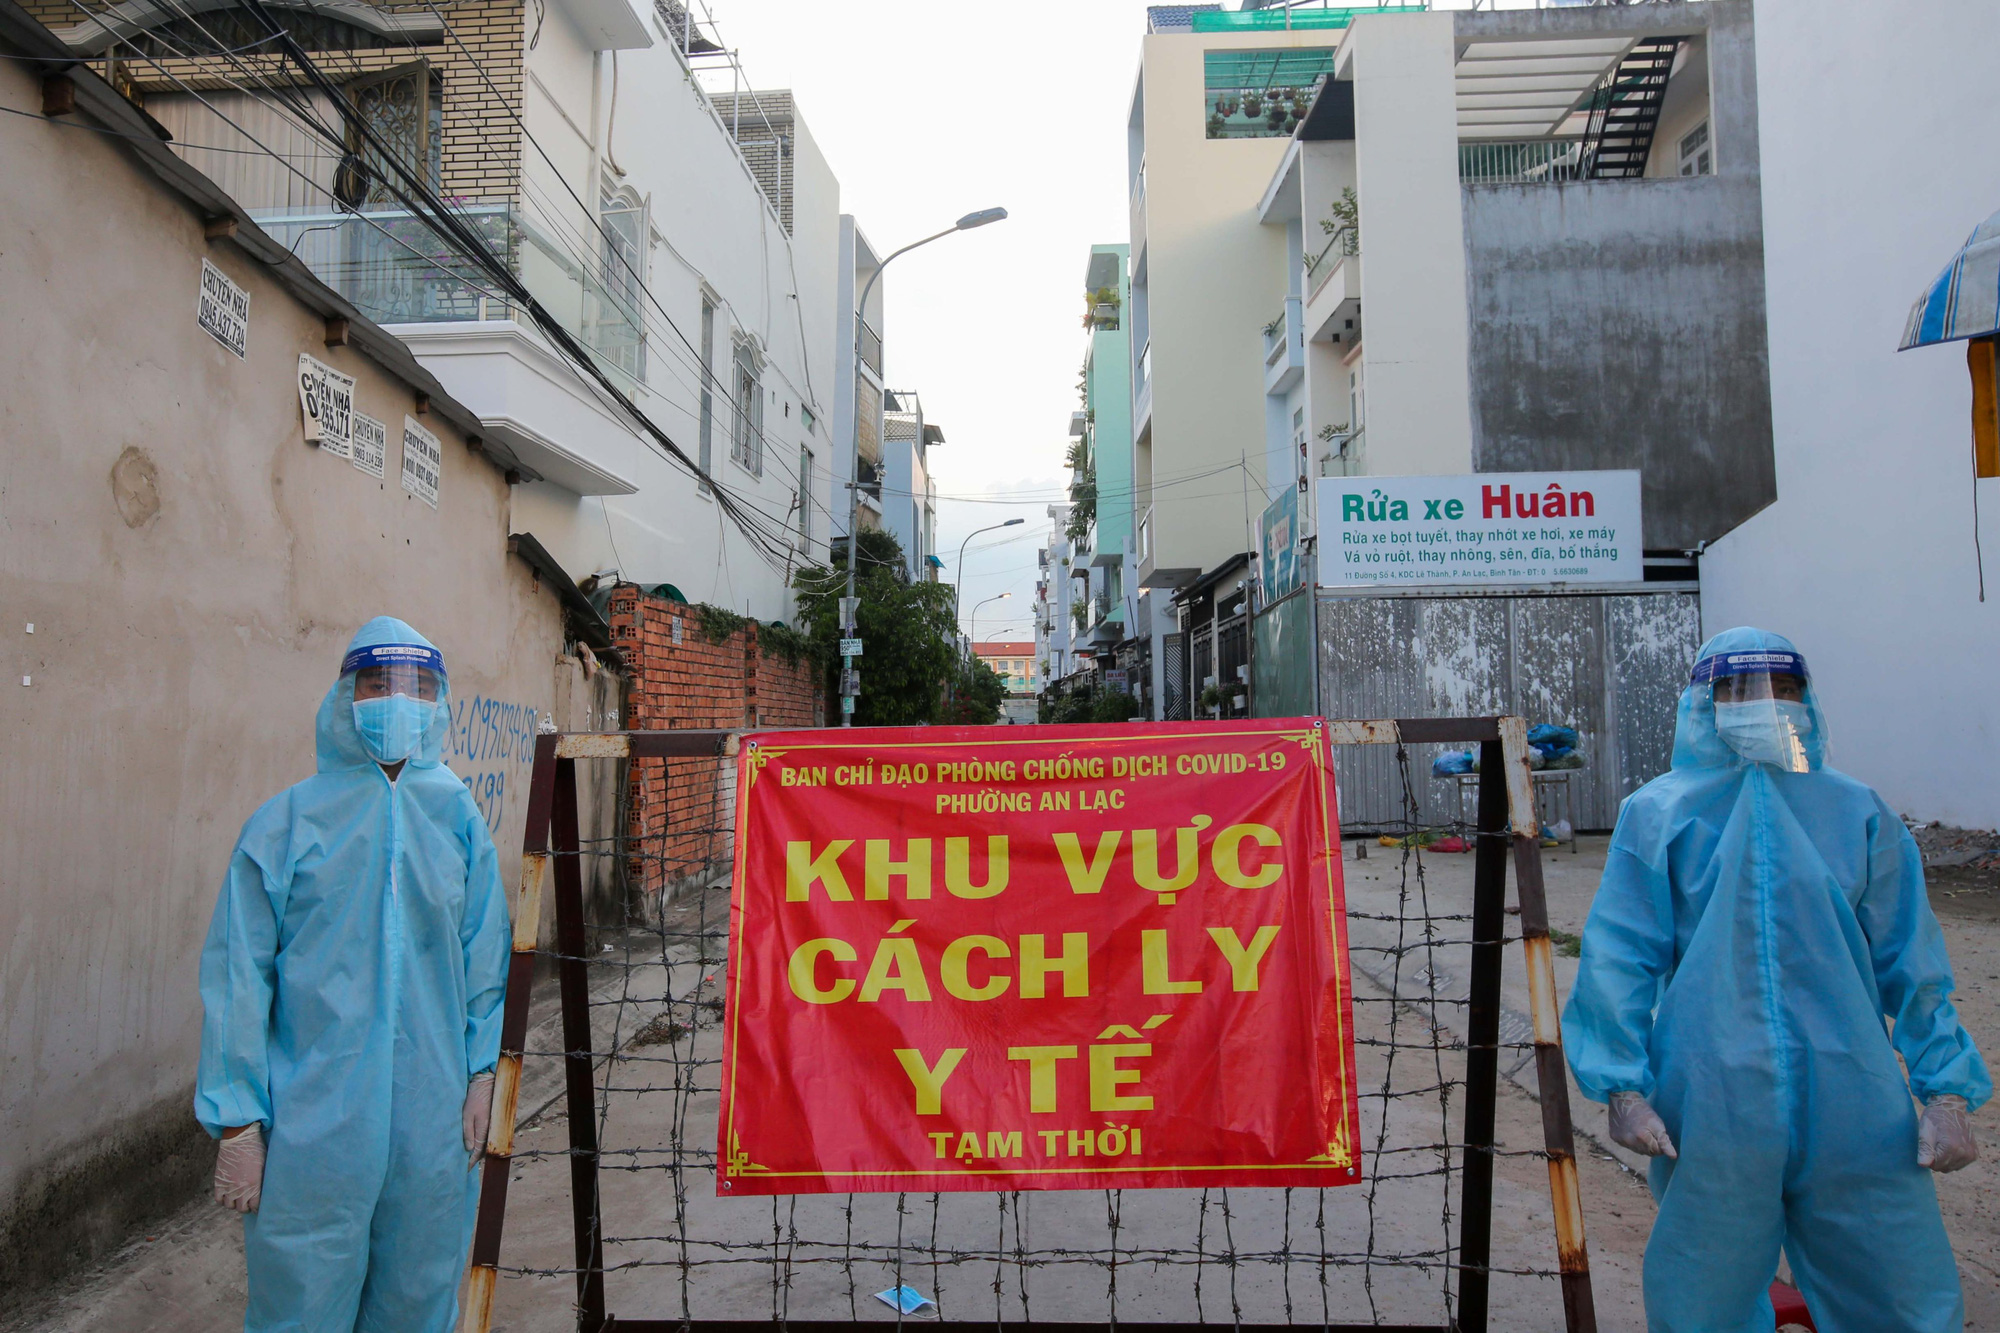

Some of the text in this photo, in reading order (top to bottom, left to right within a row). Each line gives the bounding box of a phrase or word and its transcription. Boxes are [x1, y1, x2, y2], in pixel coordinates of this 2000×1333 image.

[200, 295, 244, 349] 0945.437.734
[333, 389, 351, 413] NHÀ
[1342, 483, 1595, 522] Rửa xe Huân
[1343, 526, 1615, 546] Rửa xe bọt tuyết, thay nhớt xe hơi, xe máy
[1344, 542, 1618, 565] Vá vỏ ruột, thay nhông, sên, đĩa, bố thắng
[1399, 570, 1414, 578] KDC
[403, 648, 424, 656] Shield
[407, 655, 428, 663] Protection
[781, 750, 1286, 788] BAN CHỈ ĐẠO PHÒNG CHỐNG DỊCH COVID-19
[936, 788, 1125, 814] PHƯỜNG AN LẠC
[785, 814, 1284, 905] KHU VỰC
[787, 918, 1281, 1004] CÁCH LY
[892, 1014, 1174, 1115] Y TẾ
[928, 1121, 1142, 1164] TẠM THỜI
